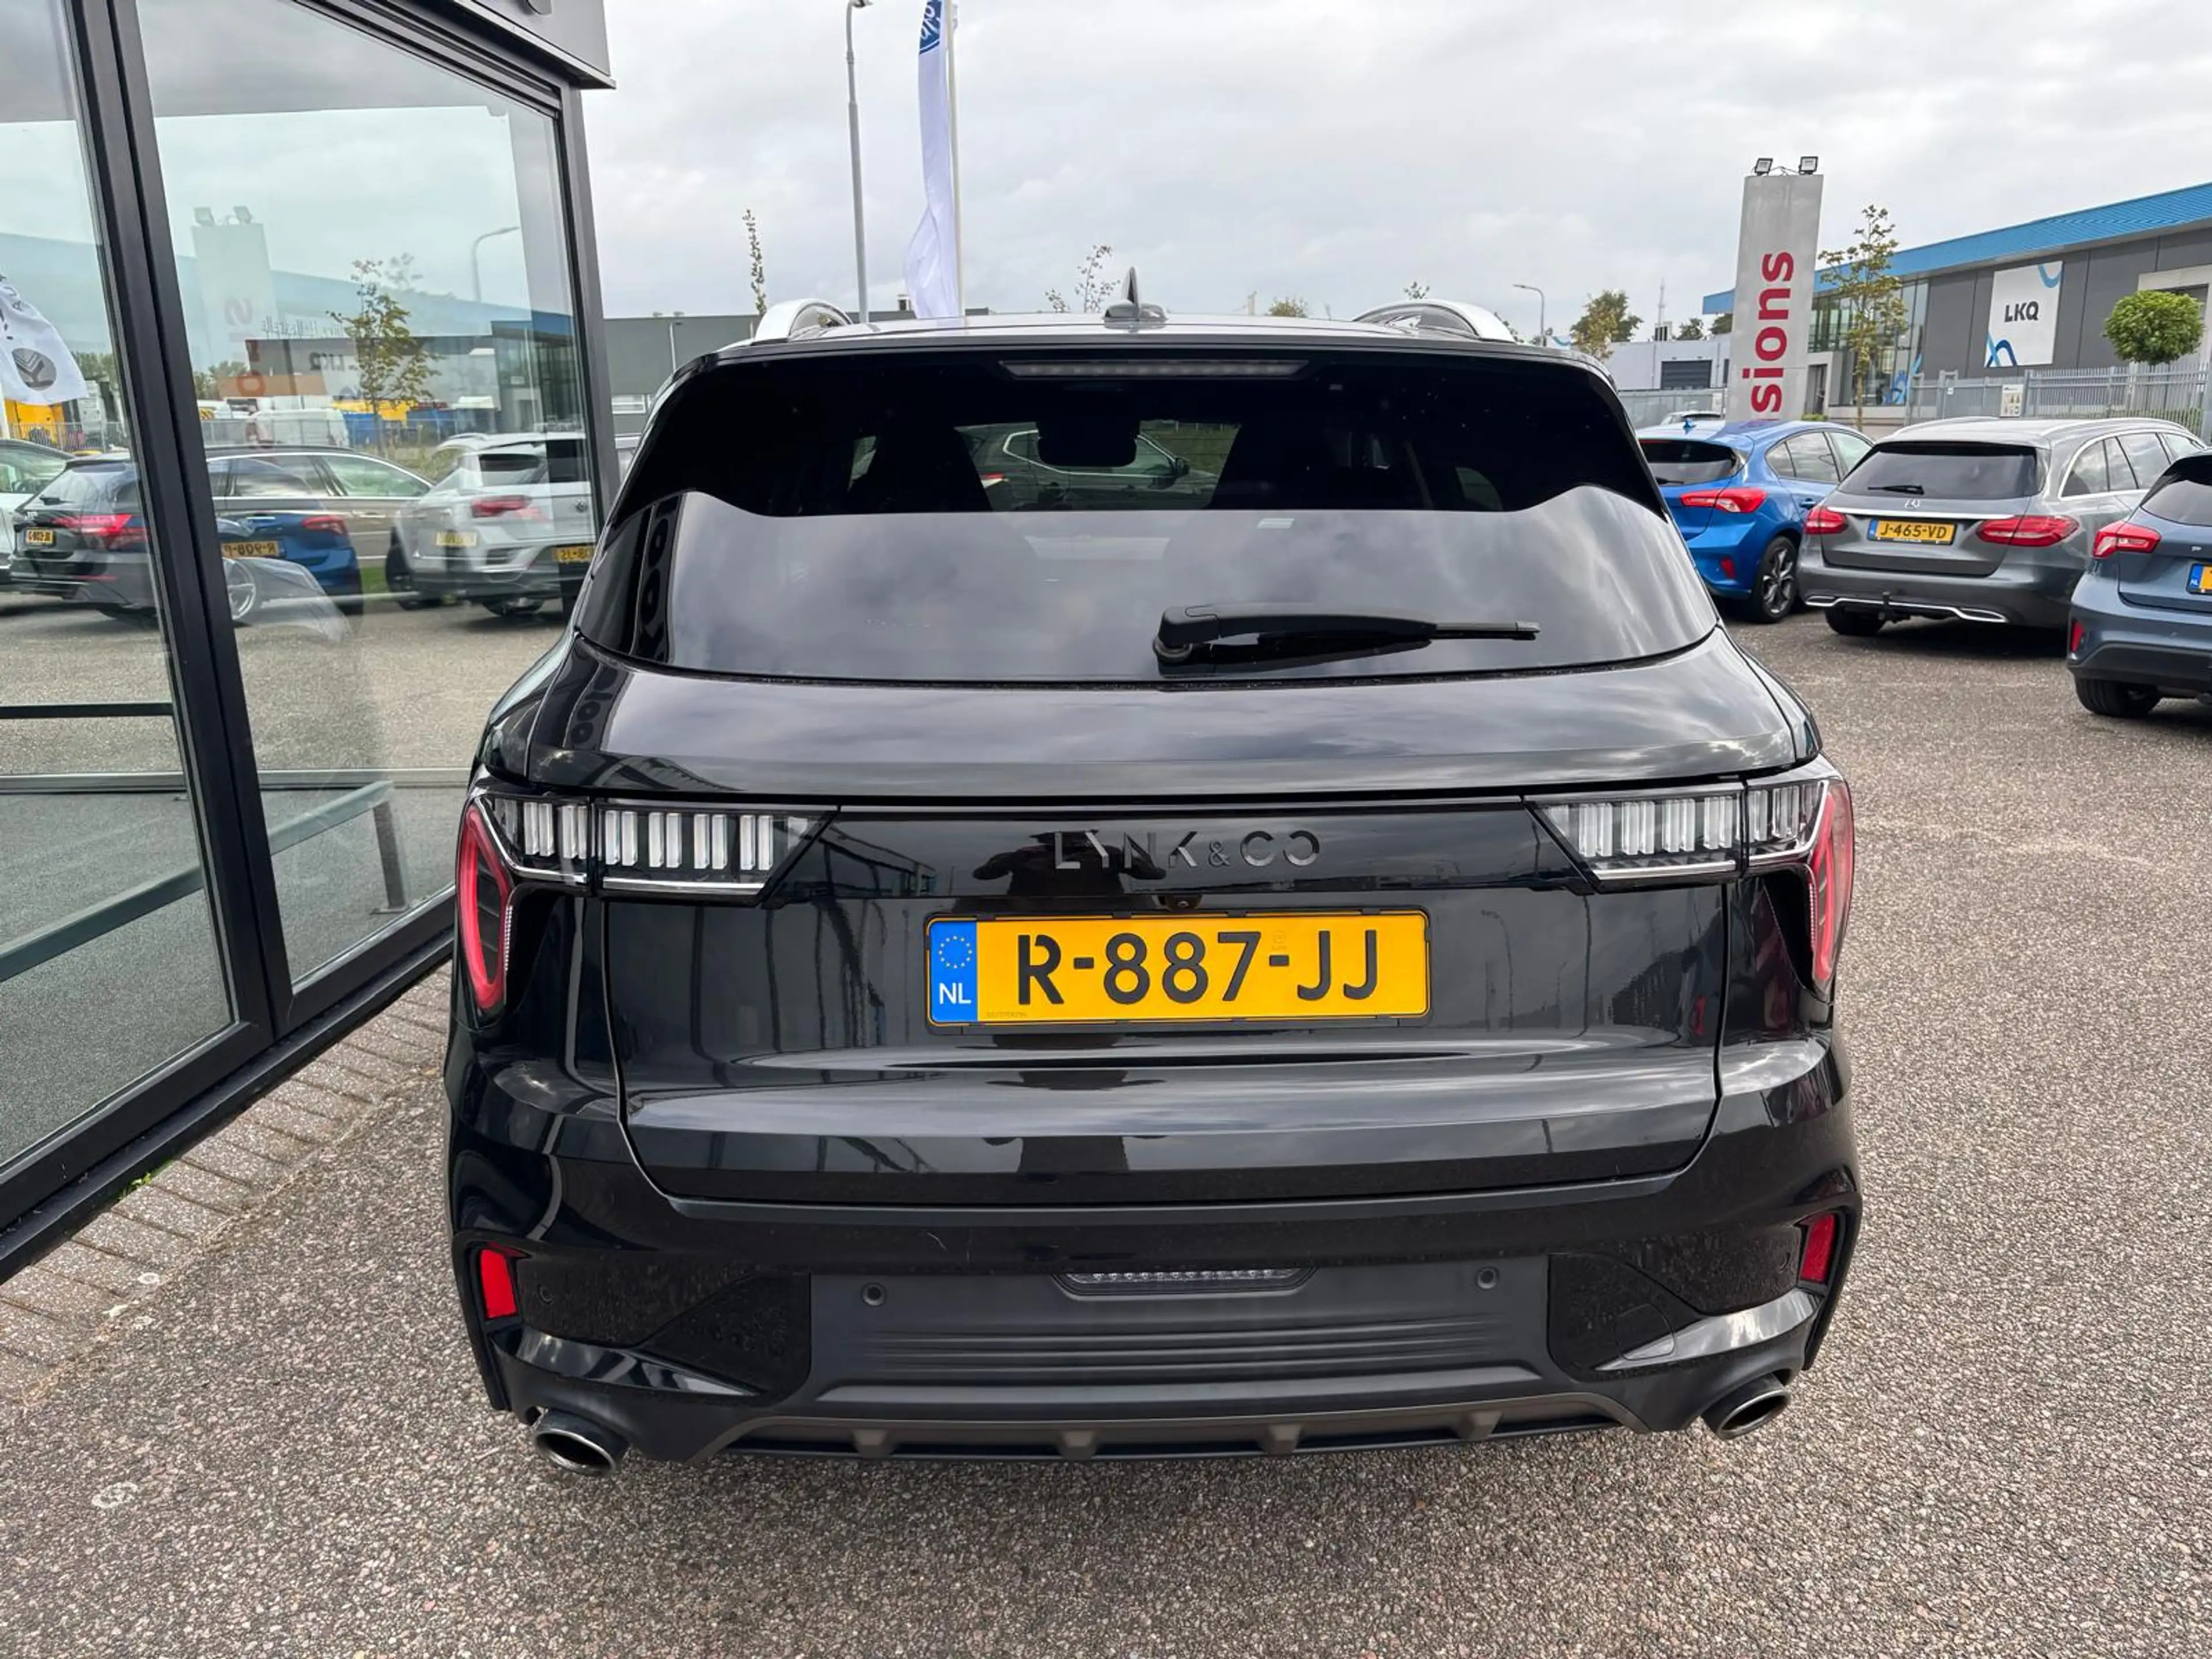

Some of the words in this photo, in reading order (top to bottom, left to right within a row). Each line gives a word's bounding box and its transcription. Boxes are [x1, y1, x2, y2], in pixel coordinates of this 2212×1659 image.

[2004, 301, 2039, 322] LKQ
[1741, 252, 1794, 421] sions
[1880, 523, 1947, 539] J-465-VD
[1017, 929, 1377, 1005] R-887-JJ
[939, 982, 972, 1005] NL
